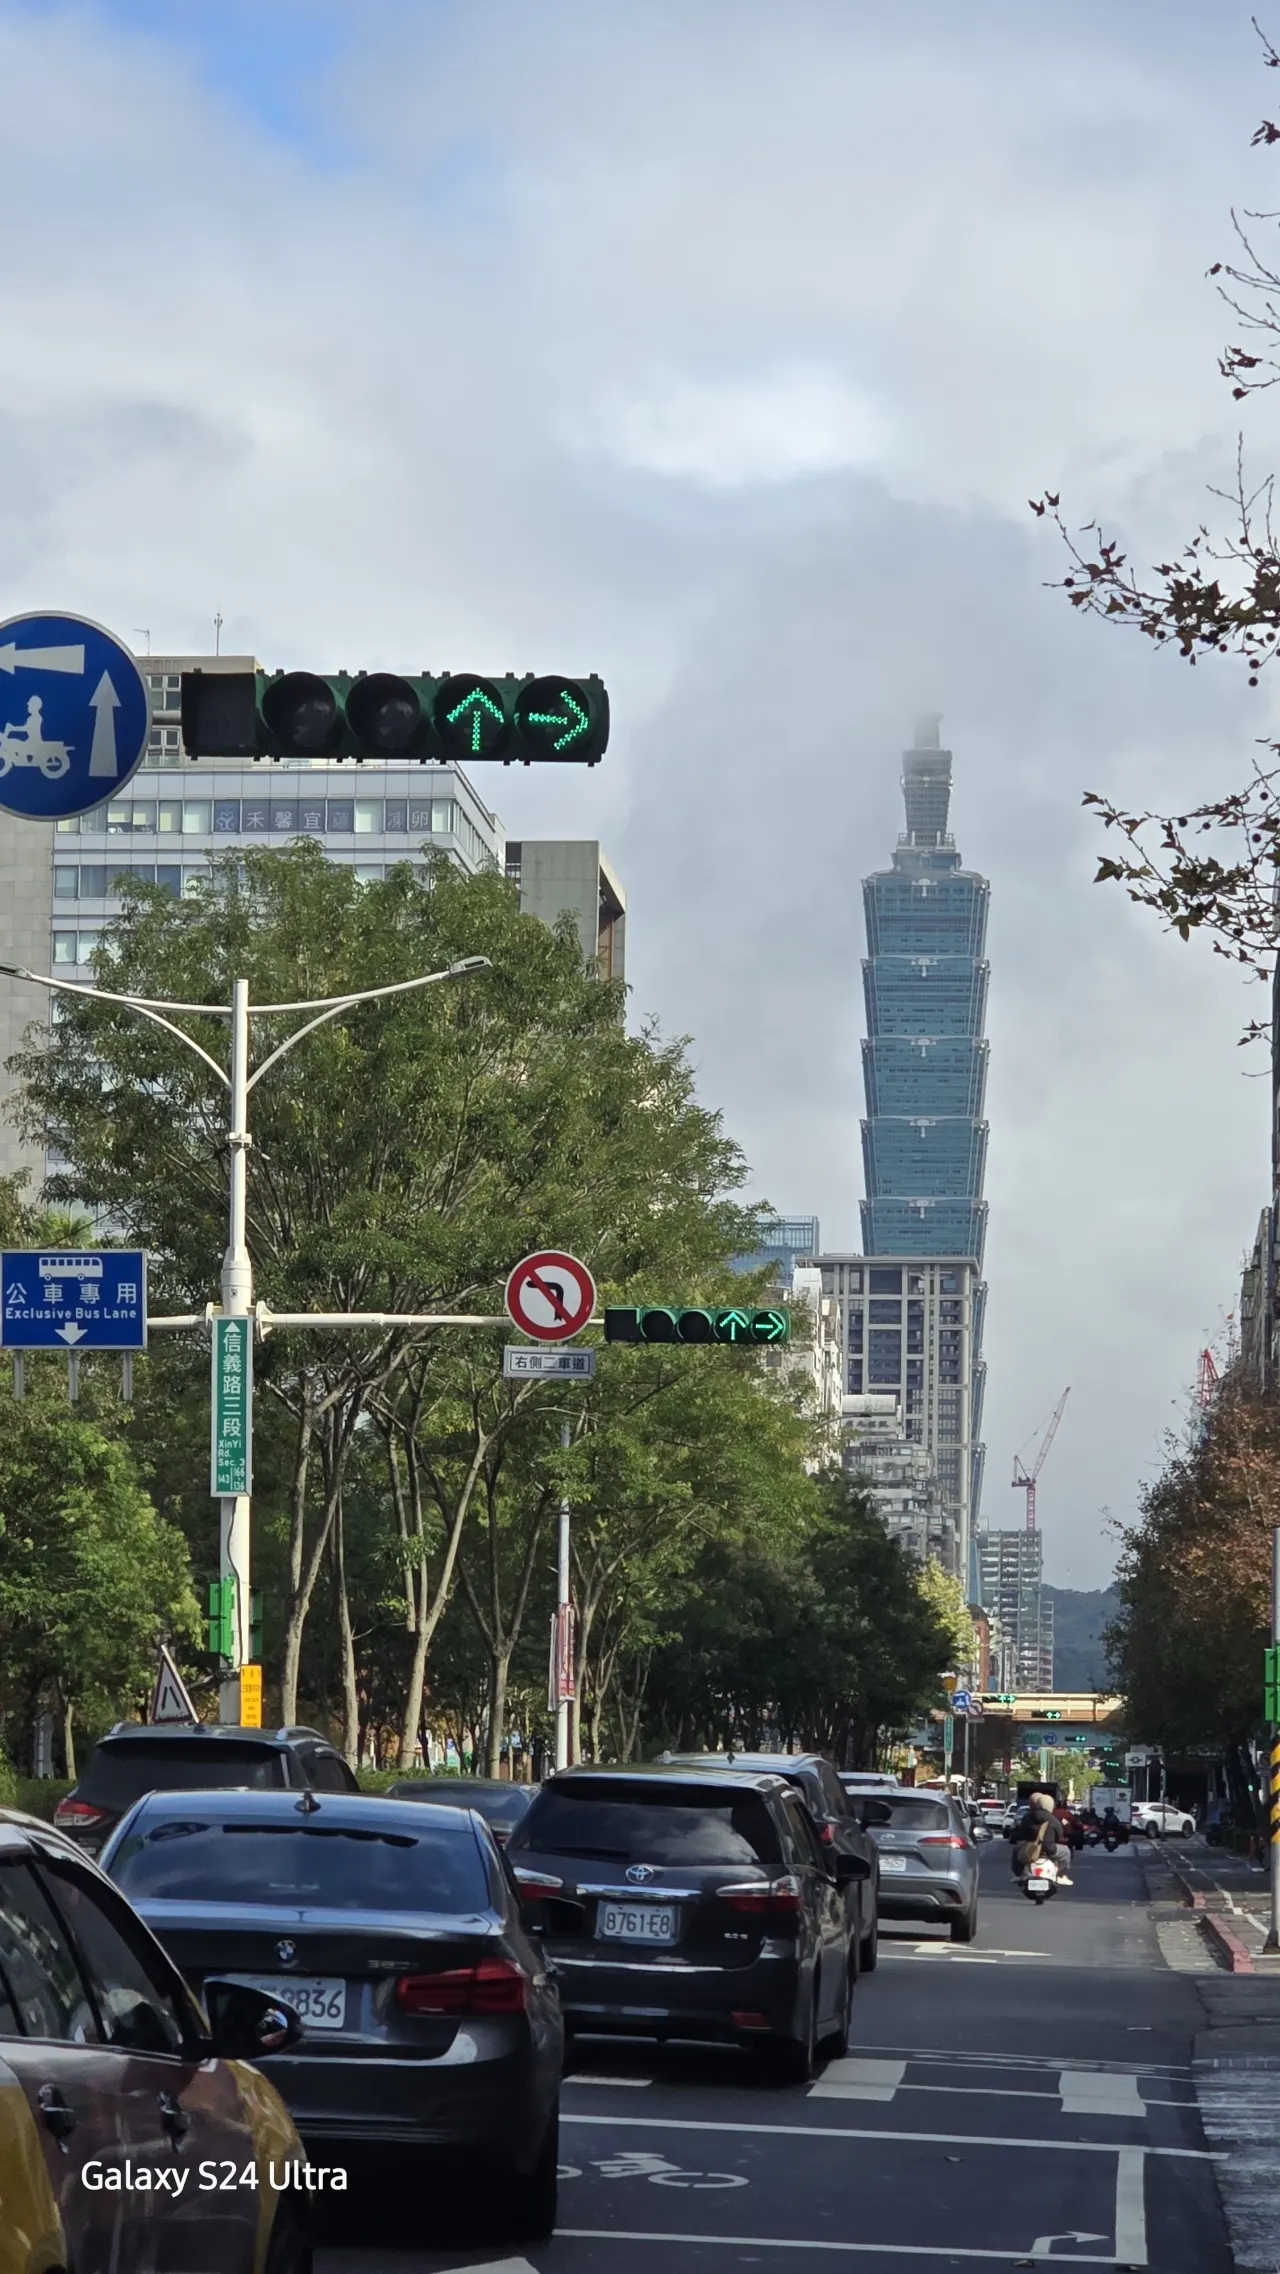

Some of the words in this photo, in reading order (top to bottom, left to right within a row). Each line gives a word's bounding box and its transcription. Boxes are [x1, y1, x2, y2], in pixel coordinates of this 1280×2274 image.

[6, 1283, 137, 1304] 公車專用
[5, 1307, 72, 1319] Exclusive
[75, 1307, 100, 1319] Bus
[104, 1307, 137, 1319] Lane
[515, 1356, 585, 1370] 右側二車道
[223, 1333, 242, 1437] 信義路三段
[218, 1449, 232, 1457] Rd.
[218, 1458, 237, 1467] Sec.
[239, 1458, 245, 1467] 3
[605, 1912, 671, 1934] 8761-E8
[260, 1985, 343, 2019] 9836
